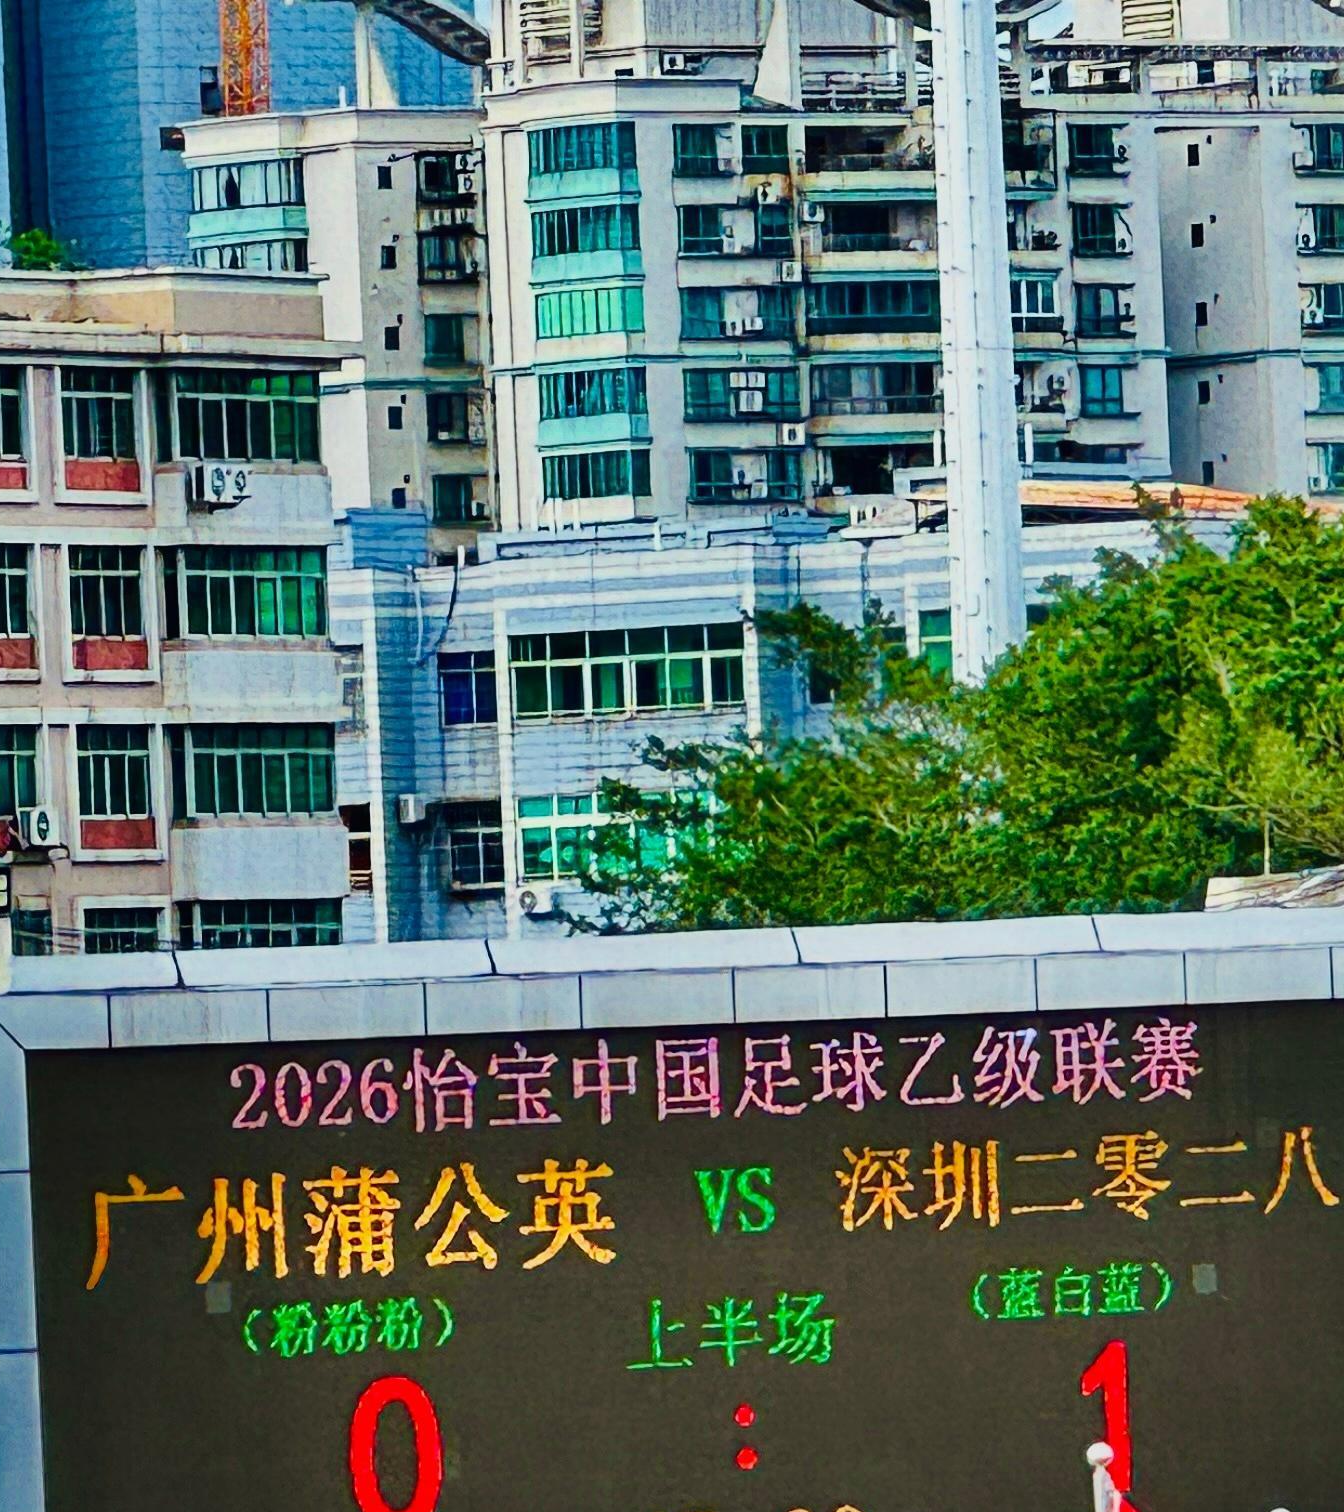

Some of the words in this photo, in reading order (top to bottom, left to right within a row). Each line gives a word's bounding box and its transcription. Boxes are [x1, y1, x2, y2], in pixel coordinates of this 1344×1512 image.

[228, 1017, 1202, 1133] 2026怡宝中国足球乙级联赛
[87, 1159, 616, 1289] 广州蒲公英
[694, 1168, 775, 1233] VS
[835, 1127, 1339, 1231] 深圳二零二八
[628, 1293, 837, 1371] 上半场
[1080, 1339, 1133, 1492] 1
